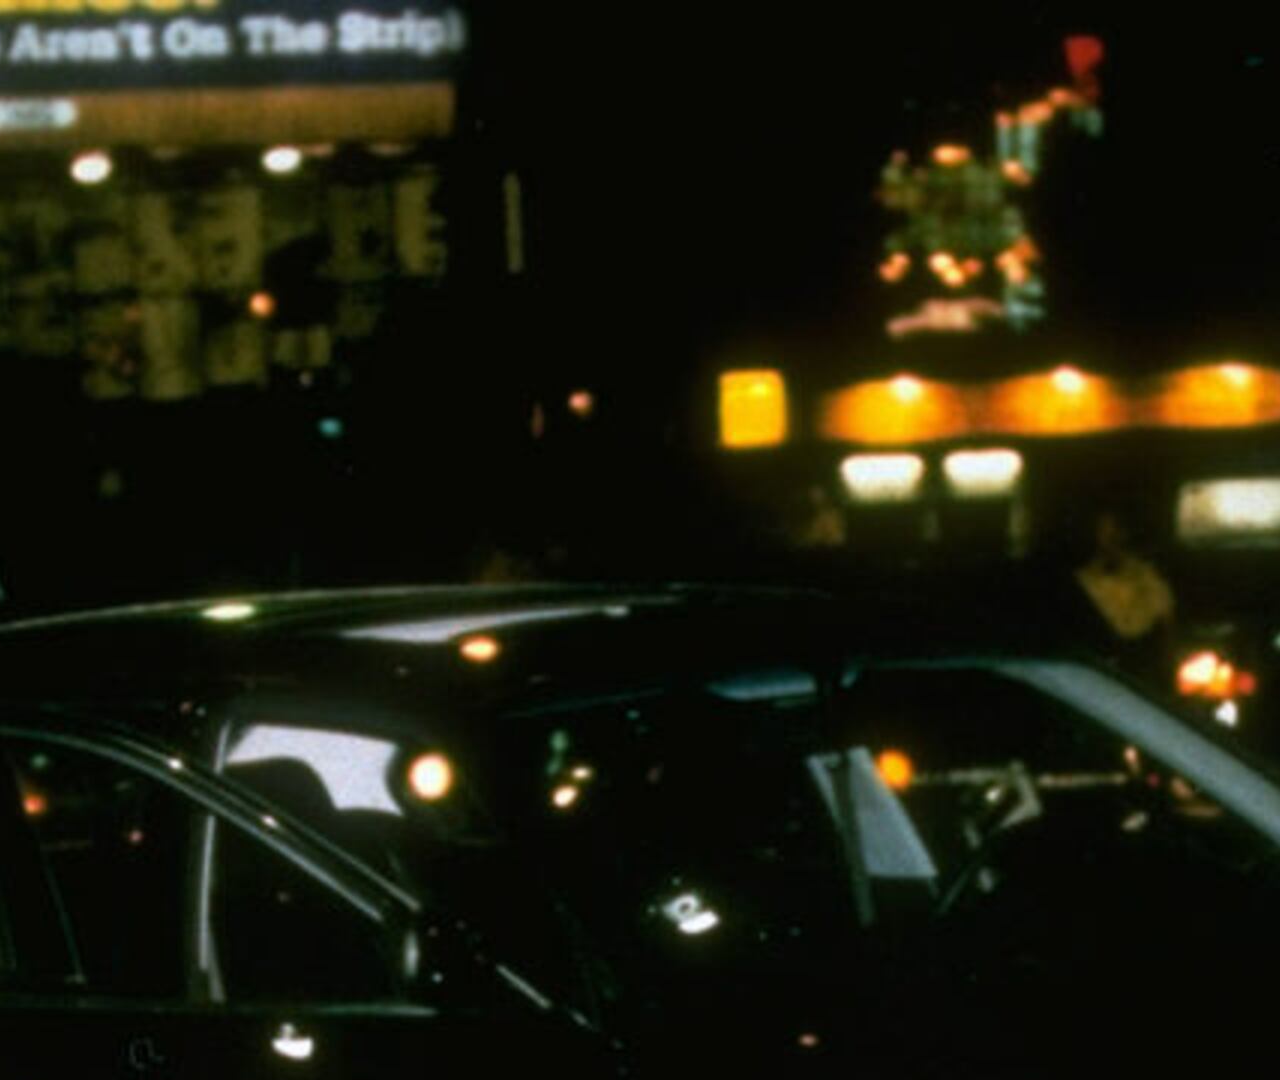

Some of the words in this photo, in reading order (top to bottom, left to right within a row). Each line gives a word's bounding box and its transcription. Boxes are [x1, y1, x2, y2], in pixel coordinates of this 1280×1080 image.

[9, 20, 154, 61] Aren't
[162, 16, 230, 58] On
[239, 13, 330, 55] The
[337, 8, 464, 57] Strip)
